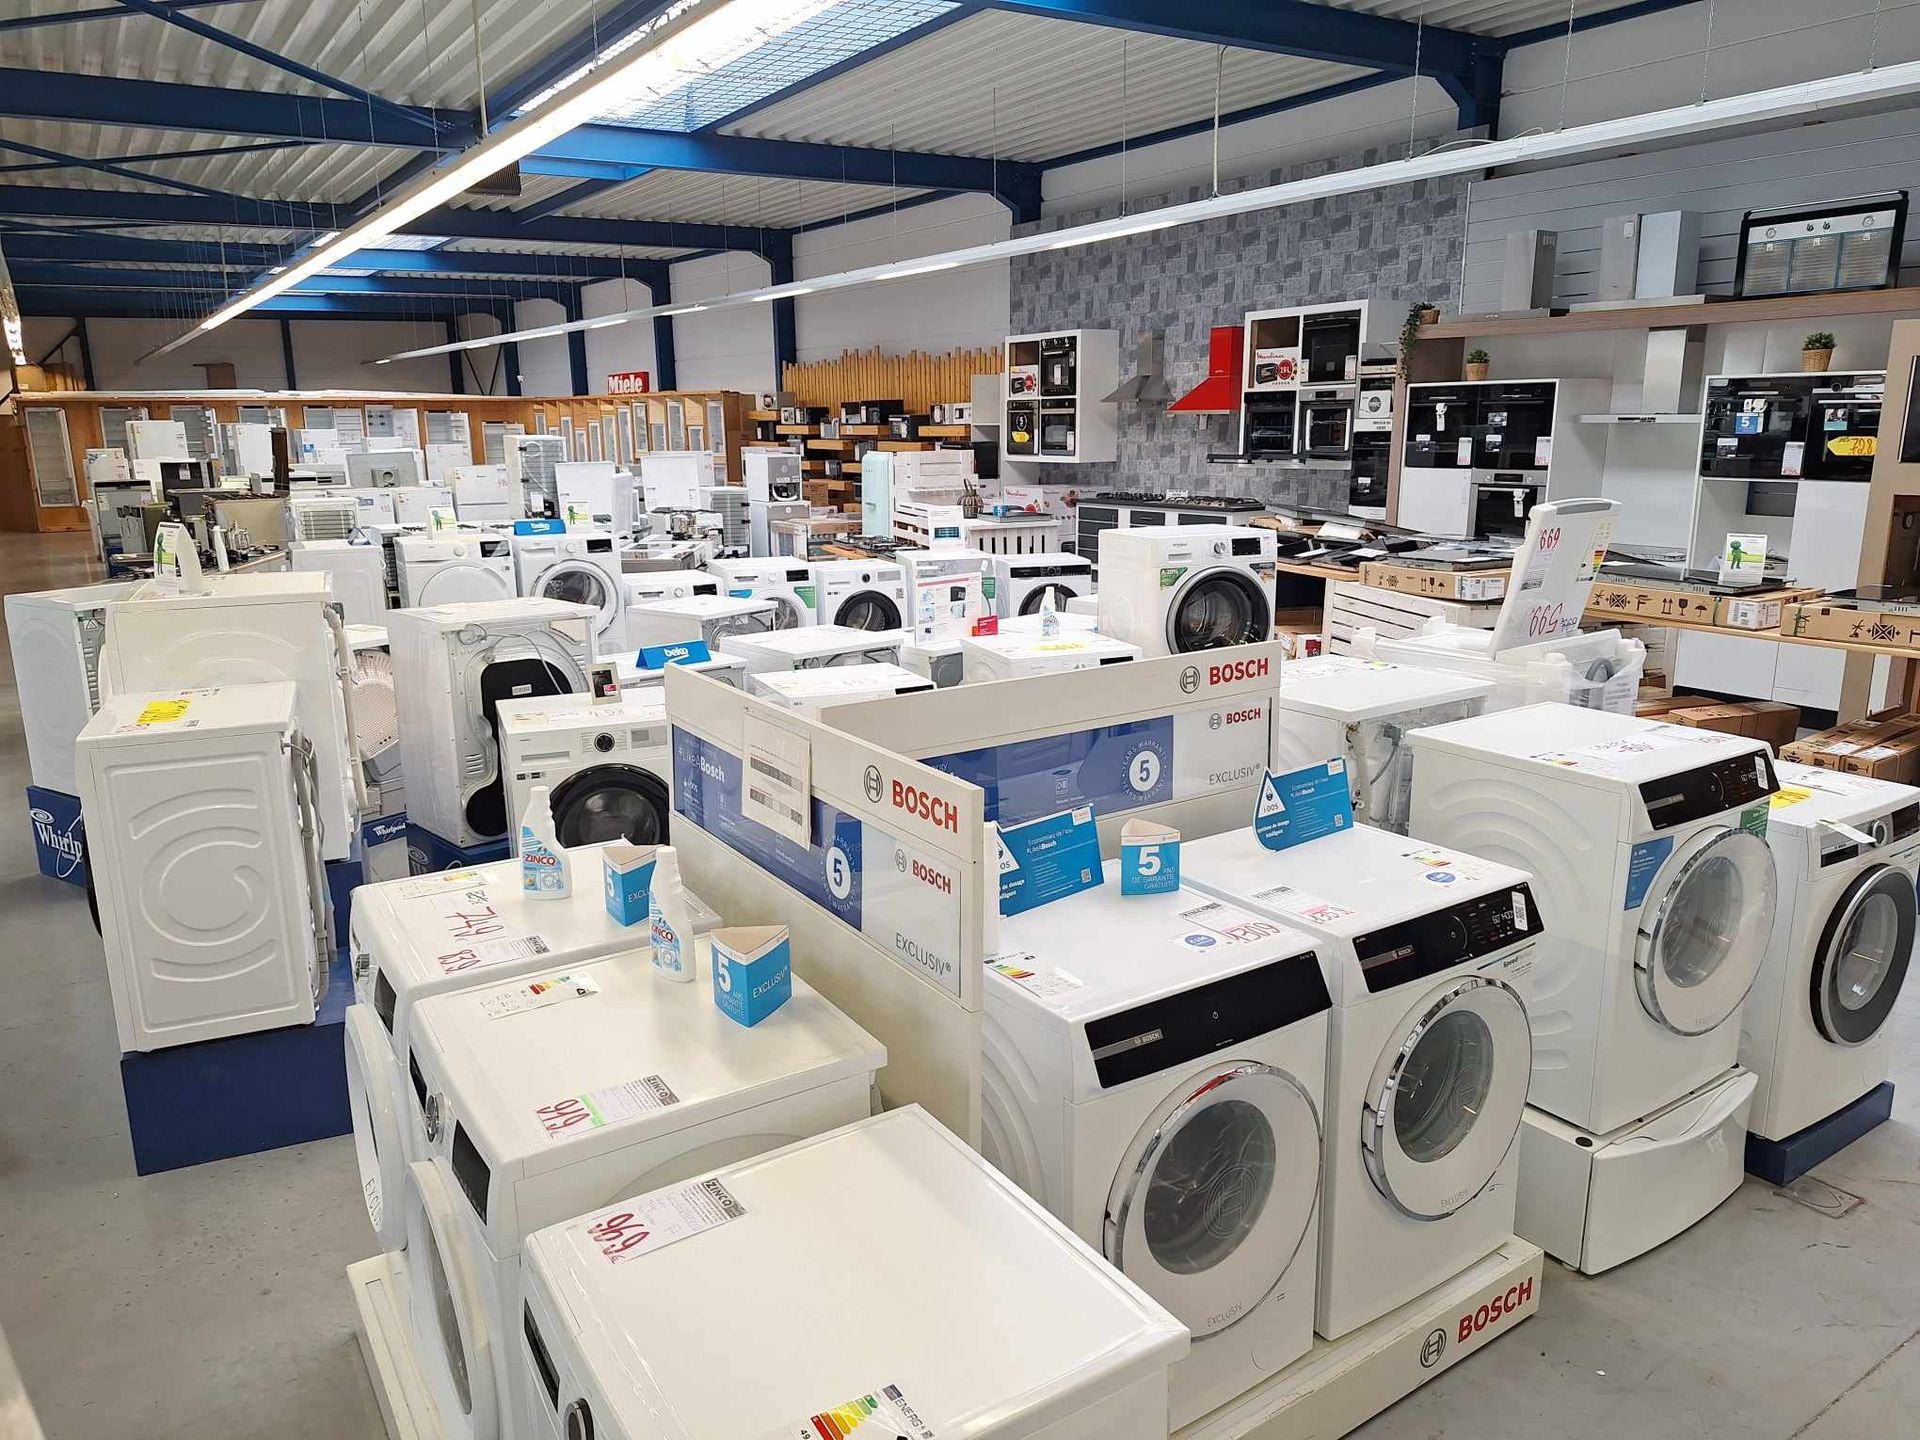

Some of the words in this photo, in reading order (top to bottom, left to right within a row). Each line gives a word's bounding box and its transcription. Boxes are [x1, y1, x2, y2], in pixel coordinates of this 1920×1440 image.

[608, 374, 643, 394] Miele
[530, 522, 550, 530] beko
[664, 646, 689, 658] beko
[1209, 657, 1269, 686] BOSCH
[1226, 707, 1261, 725] BOSCH
[1139, 759, 1151, 783] 5
[892, 779, 958, 834] BOSCH
[373, 822, 407, 837] Whirlpool
[833, 857, 844, 889] 5
[1137, 845, 1161, 877] 5
[912, 858, 952, 894] BOSCH
[717, 953, 732, 993] 5
[1206, 1302, 1243, 1328] EXCLUSIV
[1457, 1276, 1534, 1344] BOSCH
